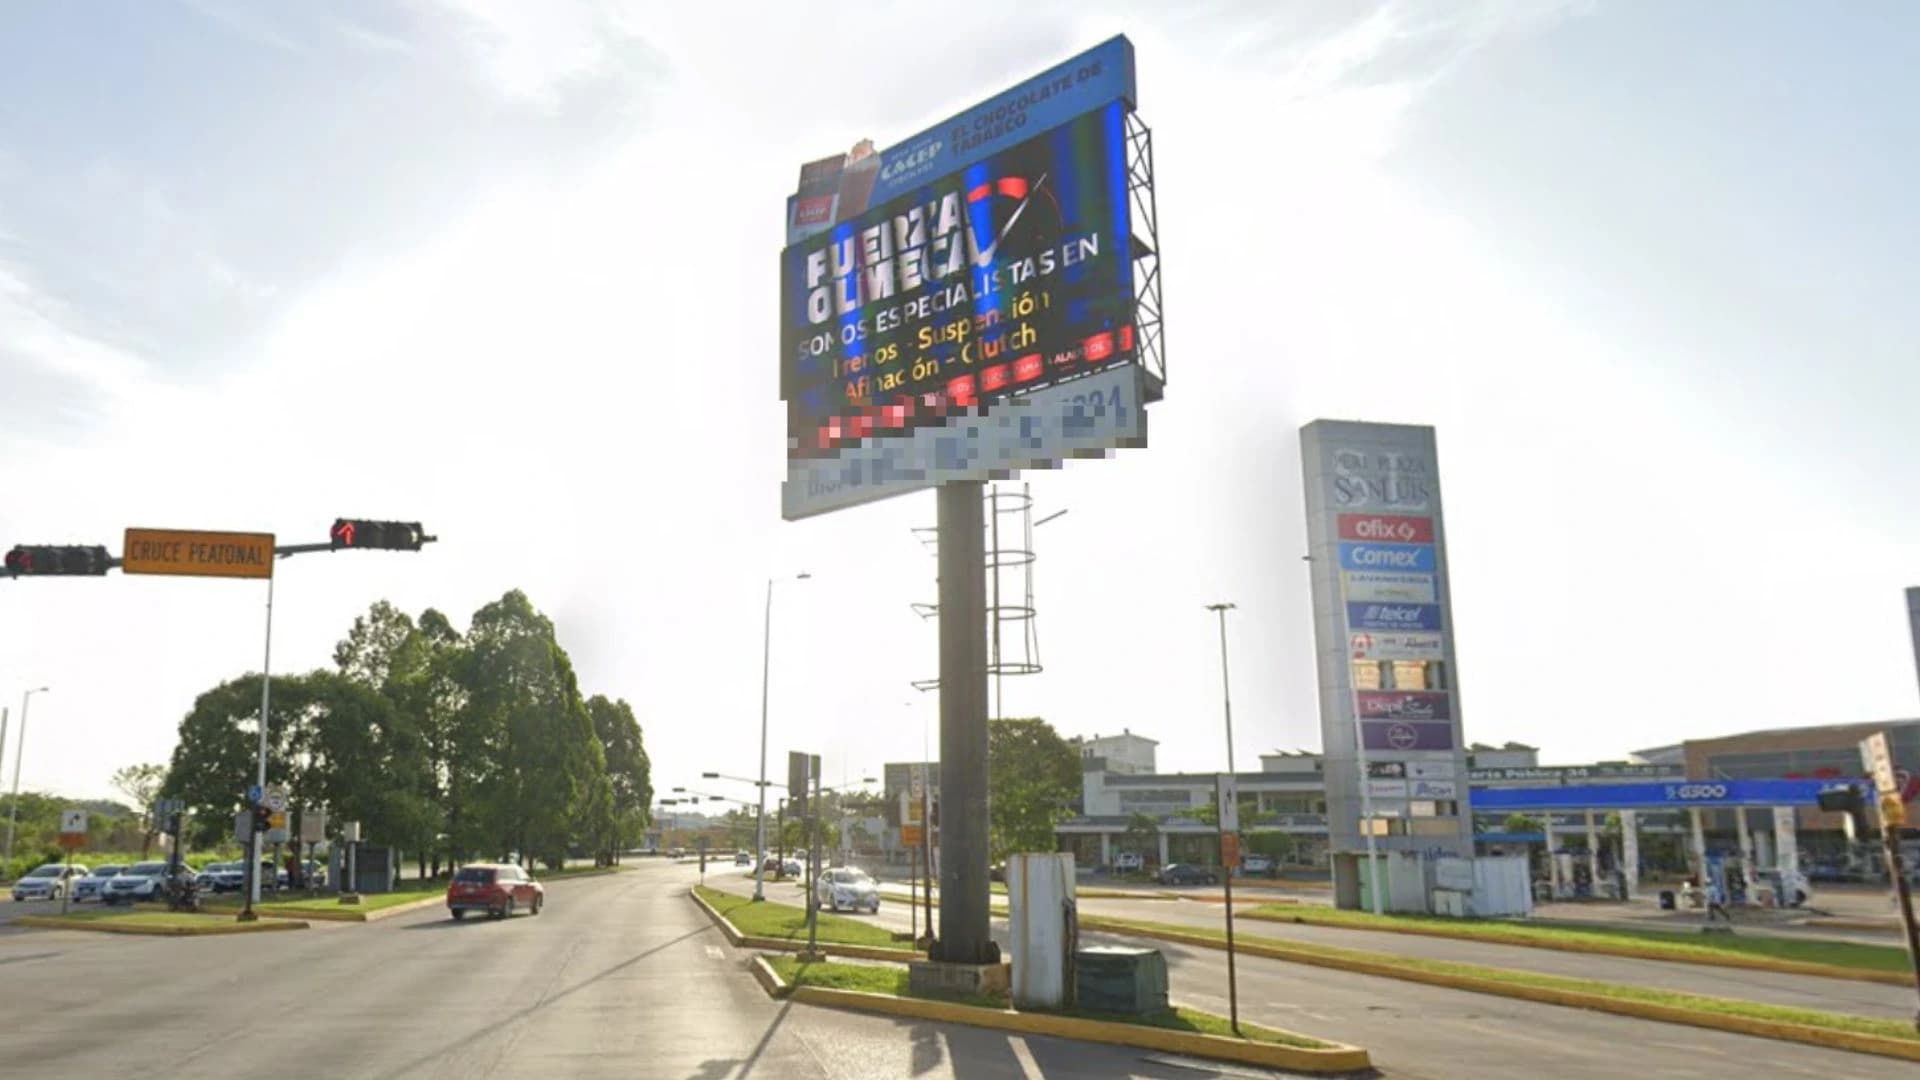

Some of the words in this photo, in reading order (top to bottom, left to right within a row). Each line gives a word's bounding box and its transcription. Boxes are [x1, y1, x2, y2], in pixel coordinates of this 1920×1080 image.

[973, 75, 1073, 130] CHOCOLATE
[1076, 61, 1103, 83] DE
[952, 114, 1027, 159] TABASCO
[1063, 232, 1099, 268] EN
[131, 540, 181, 562] CRUCE
[189, 542, 265, 567] PEATONAL
[1352, 547, 1420, 566] Comex
